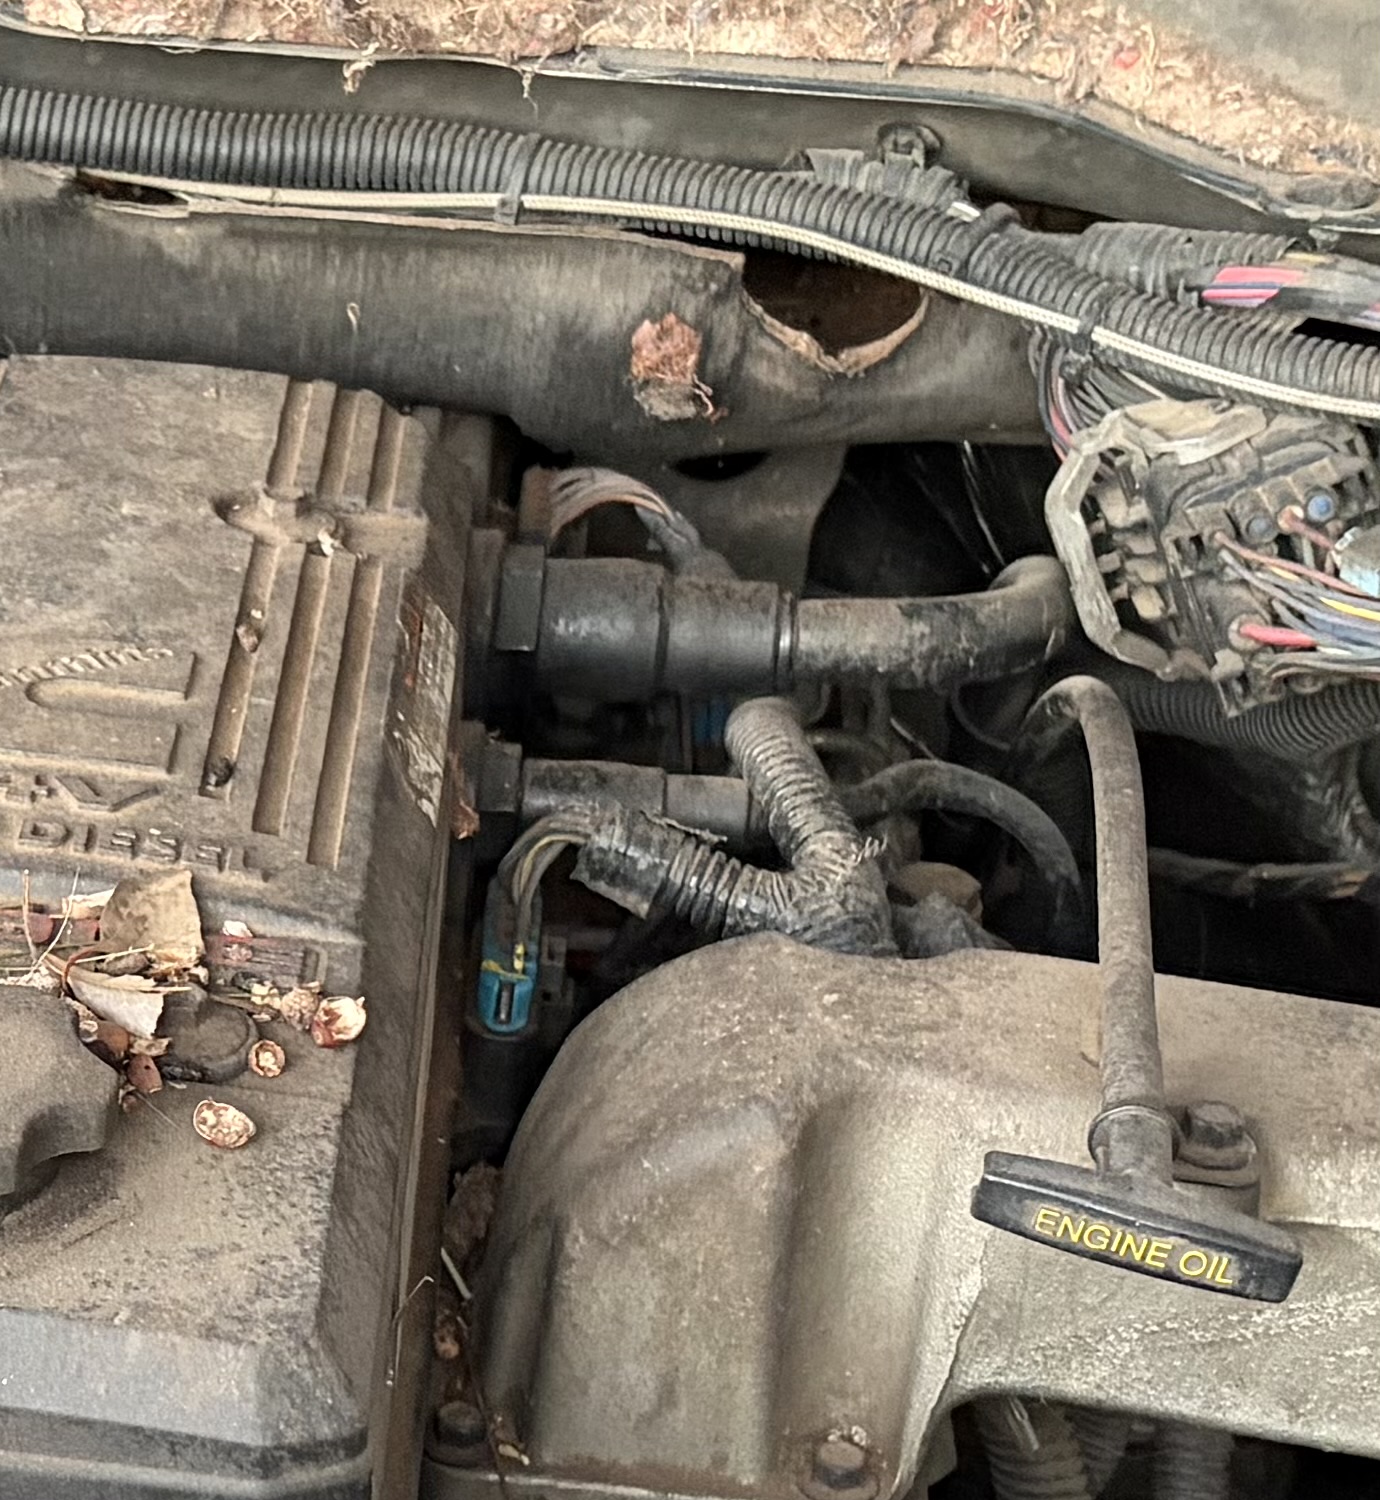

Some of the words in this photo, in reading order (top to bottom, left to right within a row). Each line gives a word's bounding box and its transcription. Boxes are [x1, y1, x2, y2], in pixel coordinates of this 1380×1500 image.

[15, 814, 277, 883] DIESEL
[1033, 1207, 1173, 1269] ENGINE
[1178, 1248, 1234, 1286] OIL
